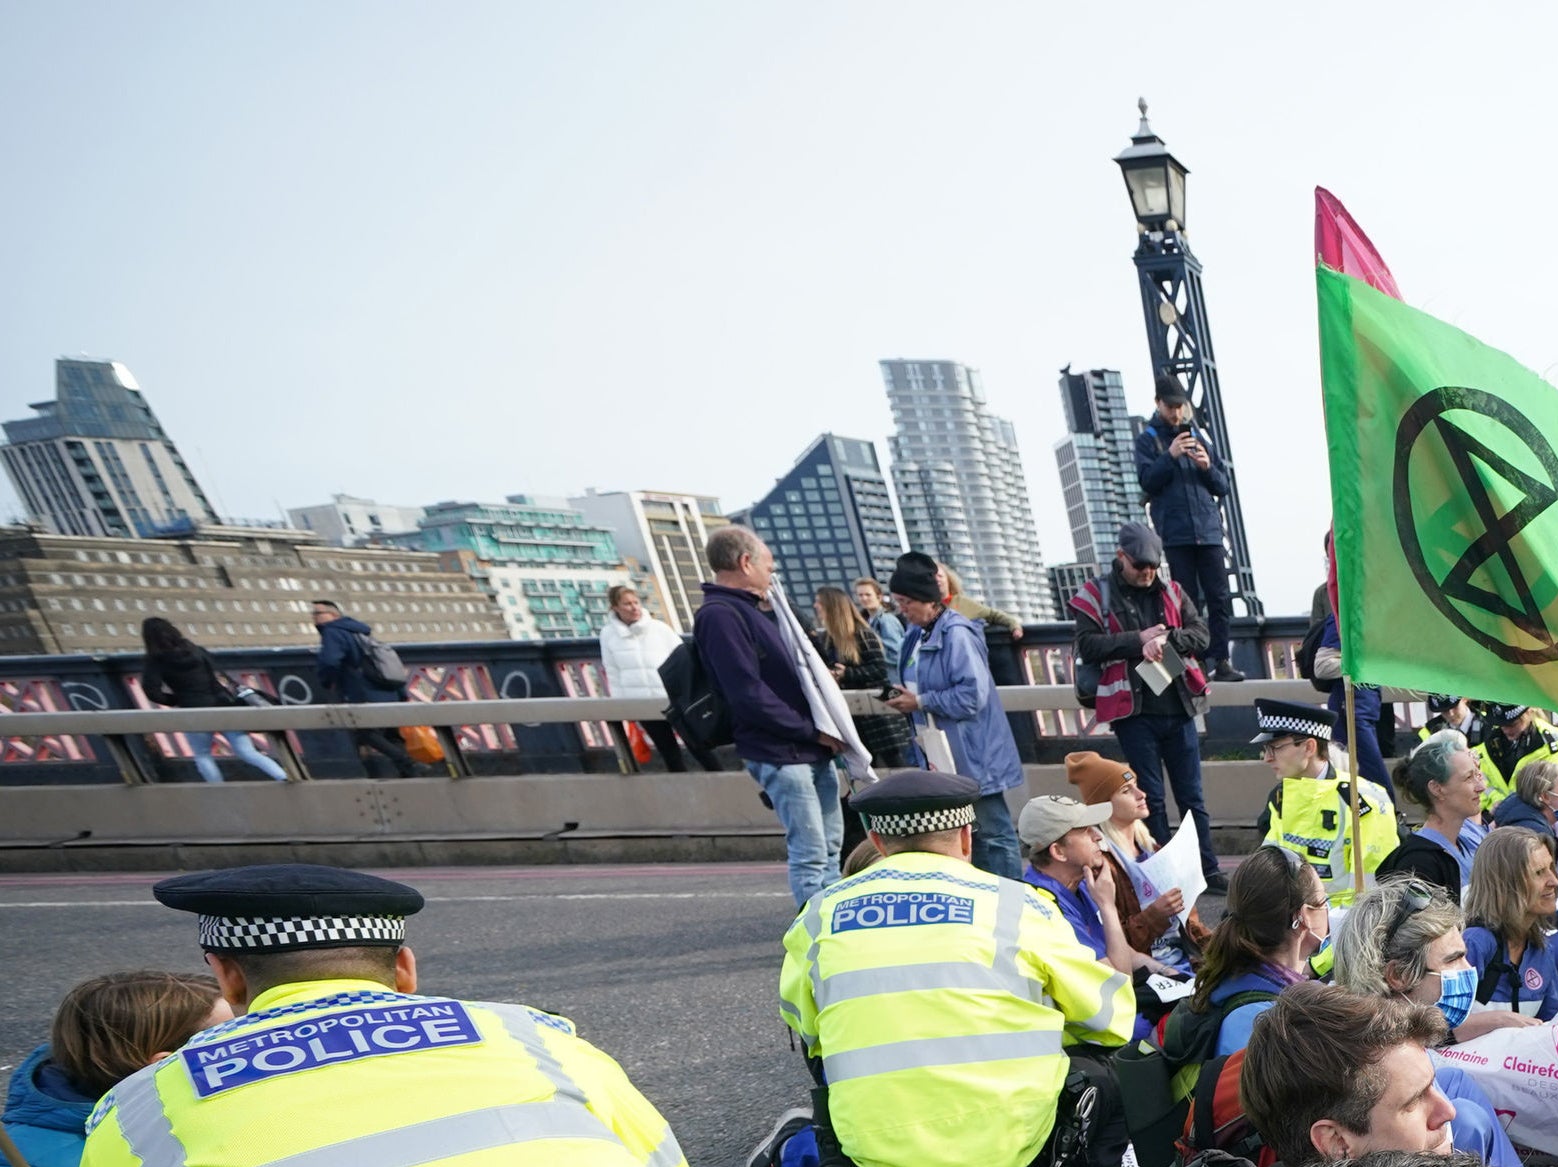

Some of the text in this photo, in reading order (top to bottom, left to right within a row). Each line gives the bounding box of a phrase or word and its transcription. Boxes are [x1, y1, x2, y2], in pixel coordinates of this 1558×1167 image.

[836, 893, 973, 911] METROPOLITAN
[833, 904, 972, 931] POLICE
[199, 1004, 455, 1065] METROPOLITAN
[202, 1018, 468, 1090] POLICE
[1436, 1046, 1489, 1066] fontaine
